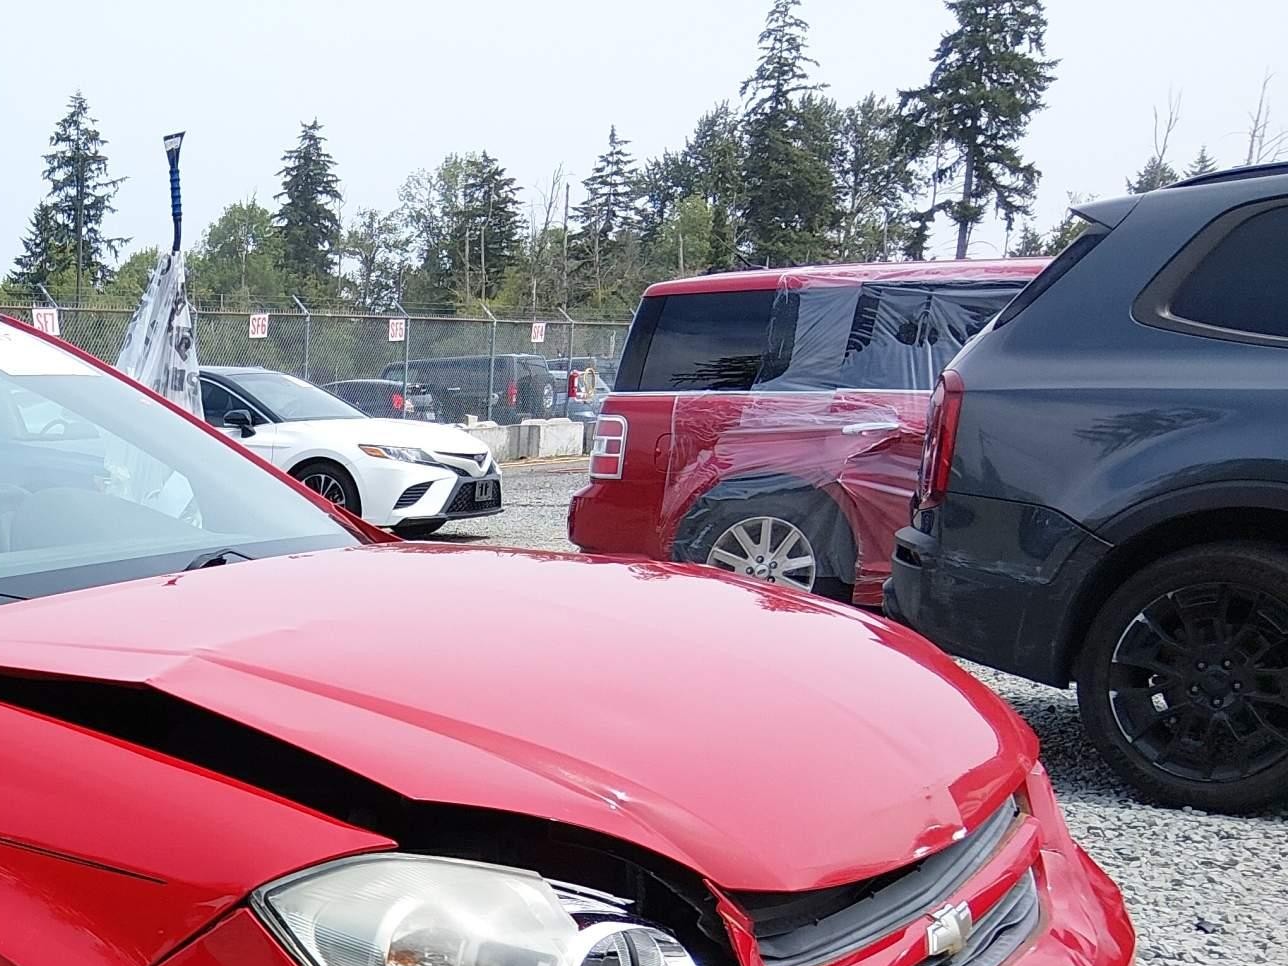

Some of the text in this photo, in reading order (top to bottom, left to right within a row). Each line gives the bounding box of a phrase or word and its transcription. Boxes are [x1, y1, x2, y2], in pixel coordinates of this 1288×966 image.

[36, 312, 55, 332] SF7
[250, 317, 267, 335] SF6
[390, 321, 404, 338] SF5
[532, 325, 544, 340] SF4
